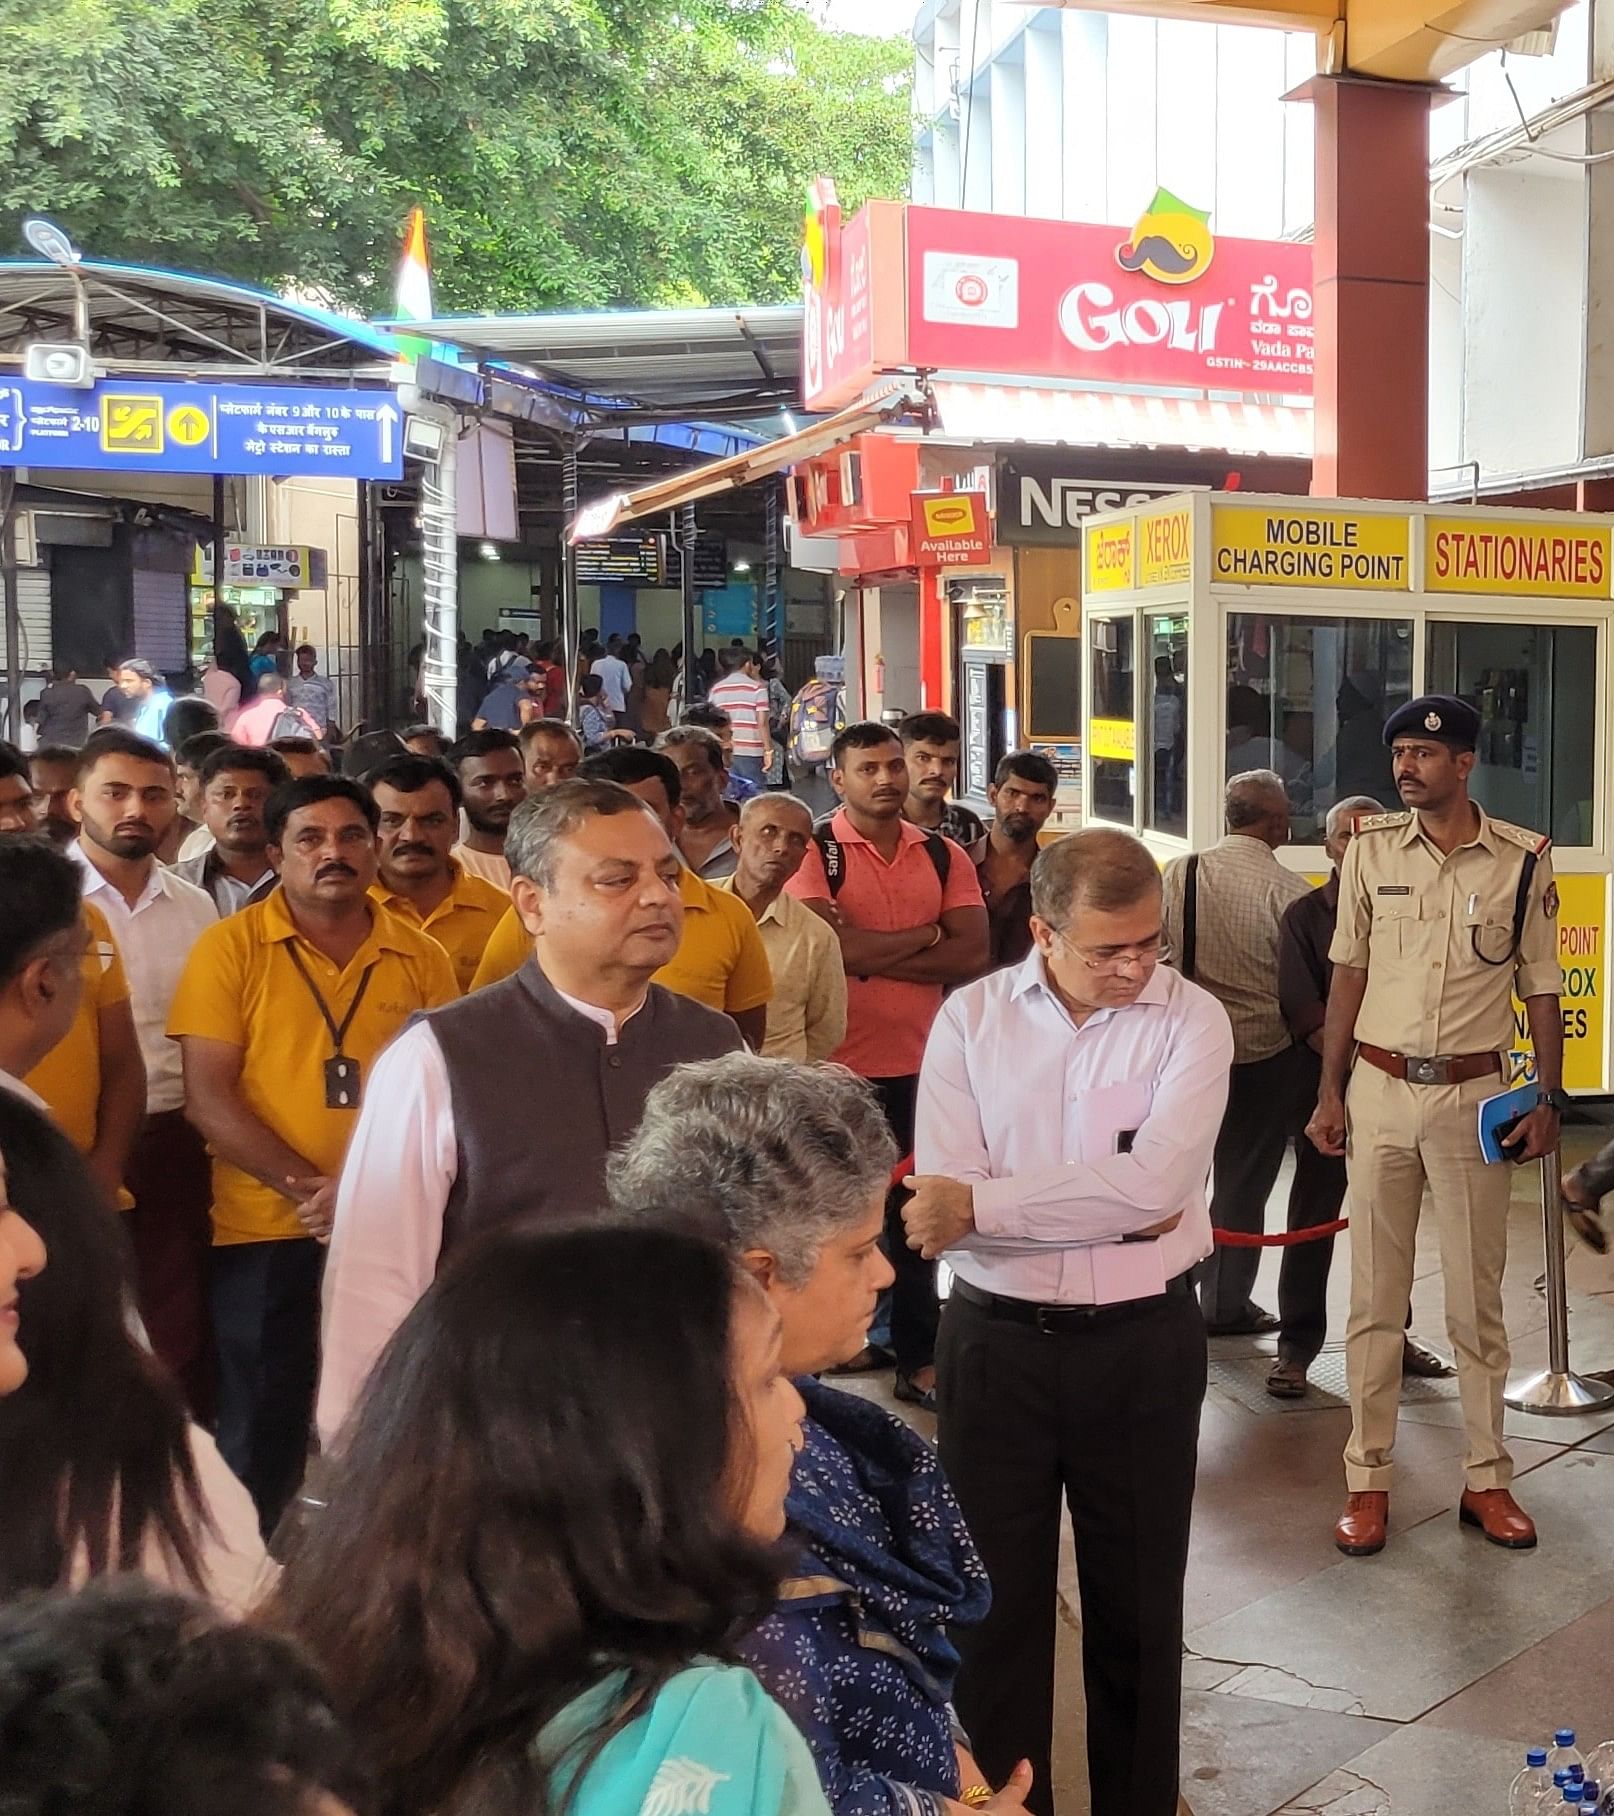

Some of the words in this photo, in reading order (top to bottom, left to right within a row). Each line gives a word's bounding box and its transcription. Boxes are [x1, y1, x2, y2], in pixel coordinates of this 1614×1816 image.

[1251, 340, 1291, 358] Vada
[72, 416, 100, 432] 2-10
[292, 406, 300, 417] 9
[326, 407, 339, 419] 10
[1147, 513, 1190, 565] XEROX
[1266, 518, 1358, 548] MOBILE
[920, 540, 984, 552] Available
[936, 551, 969, 562] Here
[1435, 532, 1603, 584] STATIONARIES
[1217, 548, 1333, 578] CHARGING
[1340, 554, 1405, 580] POINT
[1560, 926, 1599, 956] POINT
